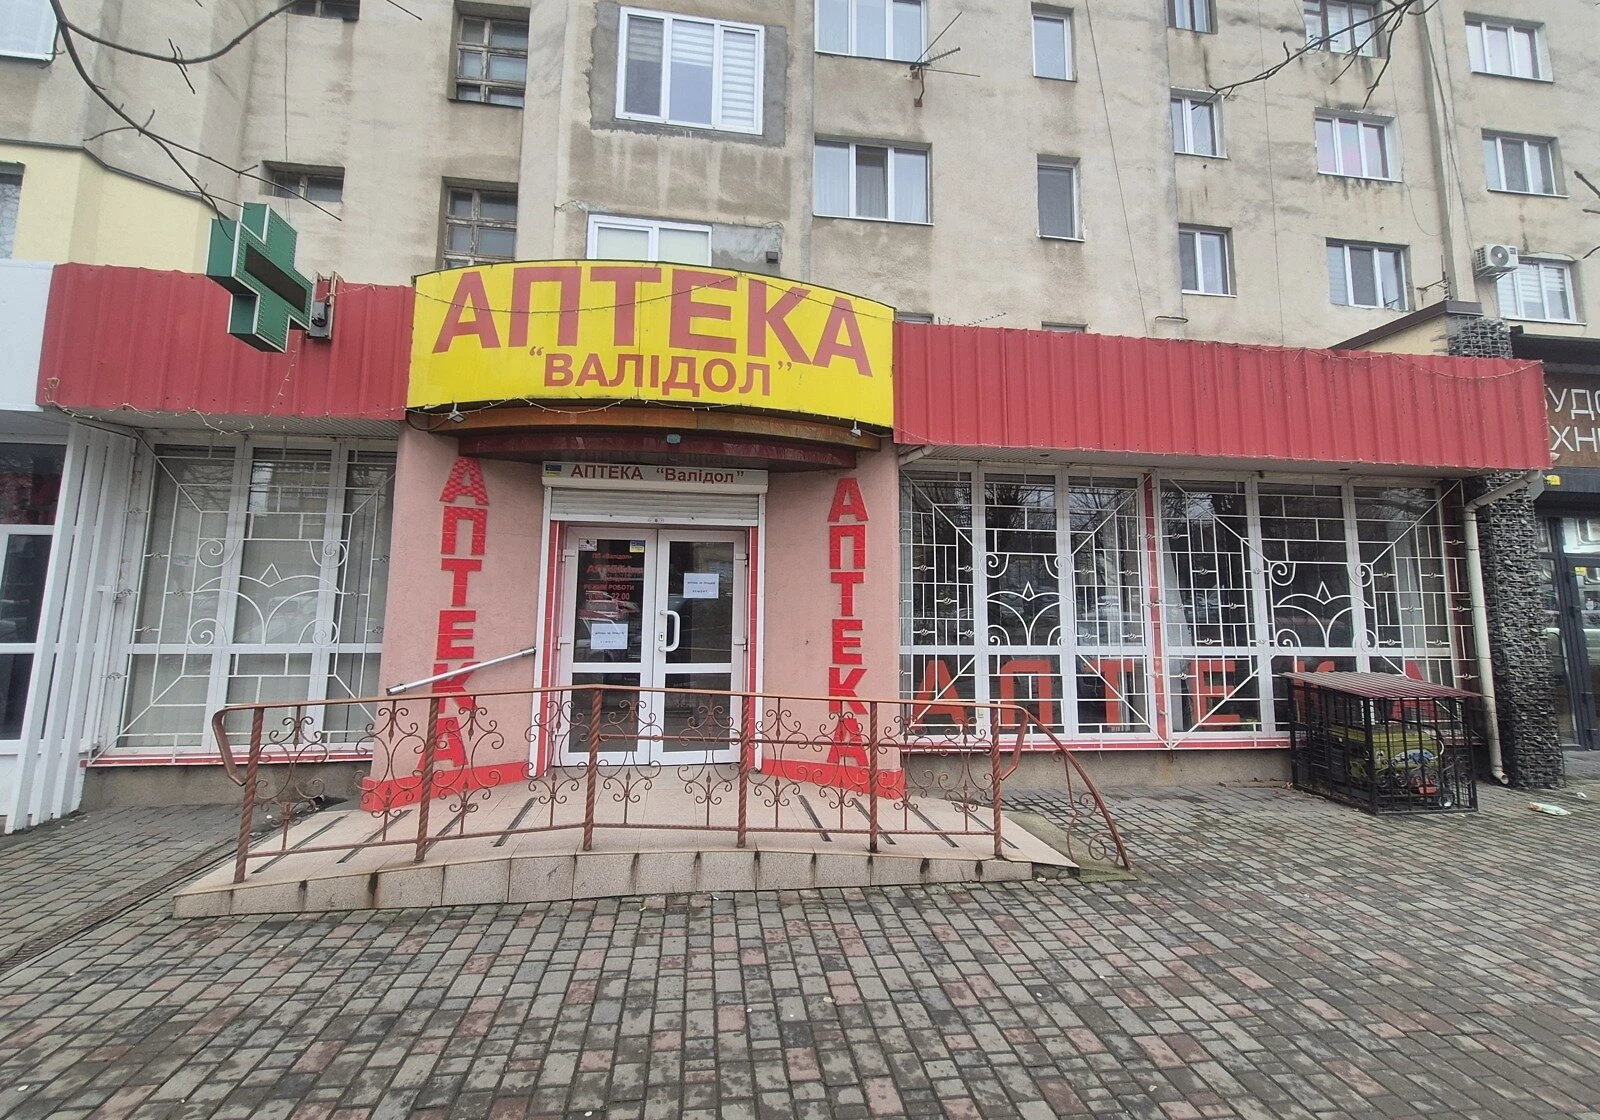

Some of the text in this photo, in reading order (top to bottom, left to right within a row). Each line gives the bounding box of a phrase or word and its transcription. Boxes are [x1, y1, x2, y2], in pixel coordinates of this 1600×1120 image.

[432, 266, 873, 377] АПТЕКА
[529, 346, 793, 397] “ВАЛІДОЛ”
[1544, 386, 1600, 421] УД
[1549, 425, 1600, 453] ХН
[570, 464, 744, 484] АПТЕКА “Валідол”
[417, 456, 490, 769] АПТЕКА
[827, 477, 869, 767] АПТЕКА
